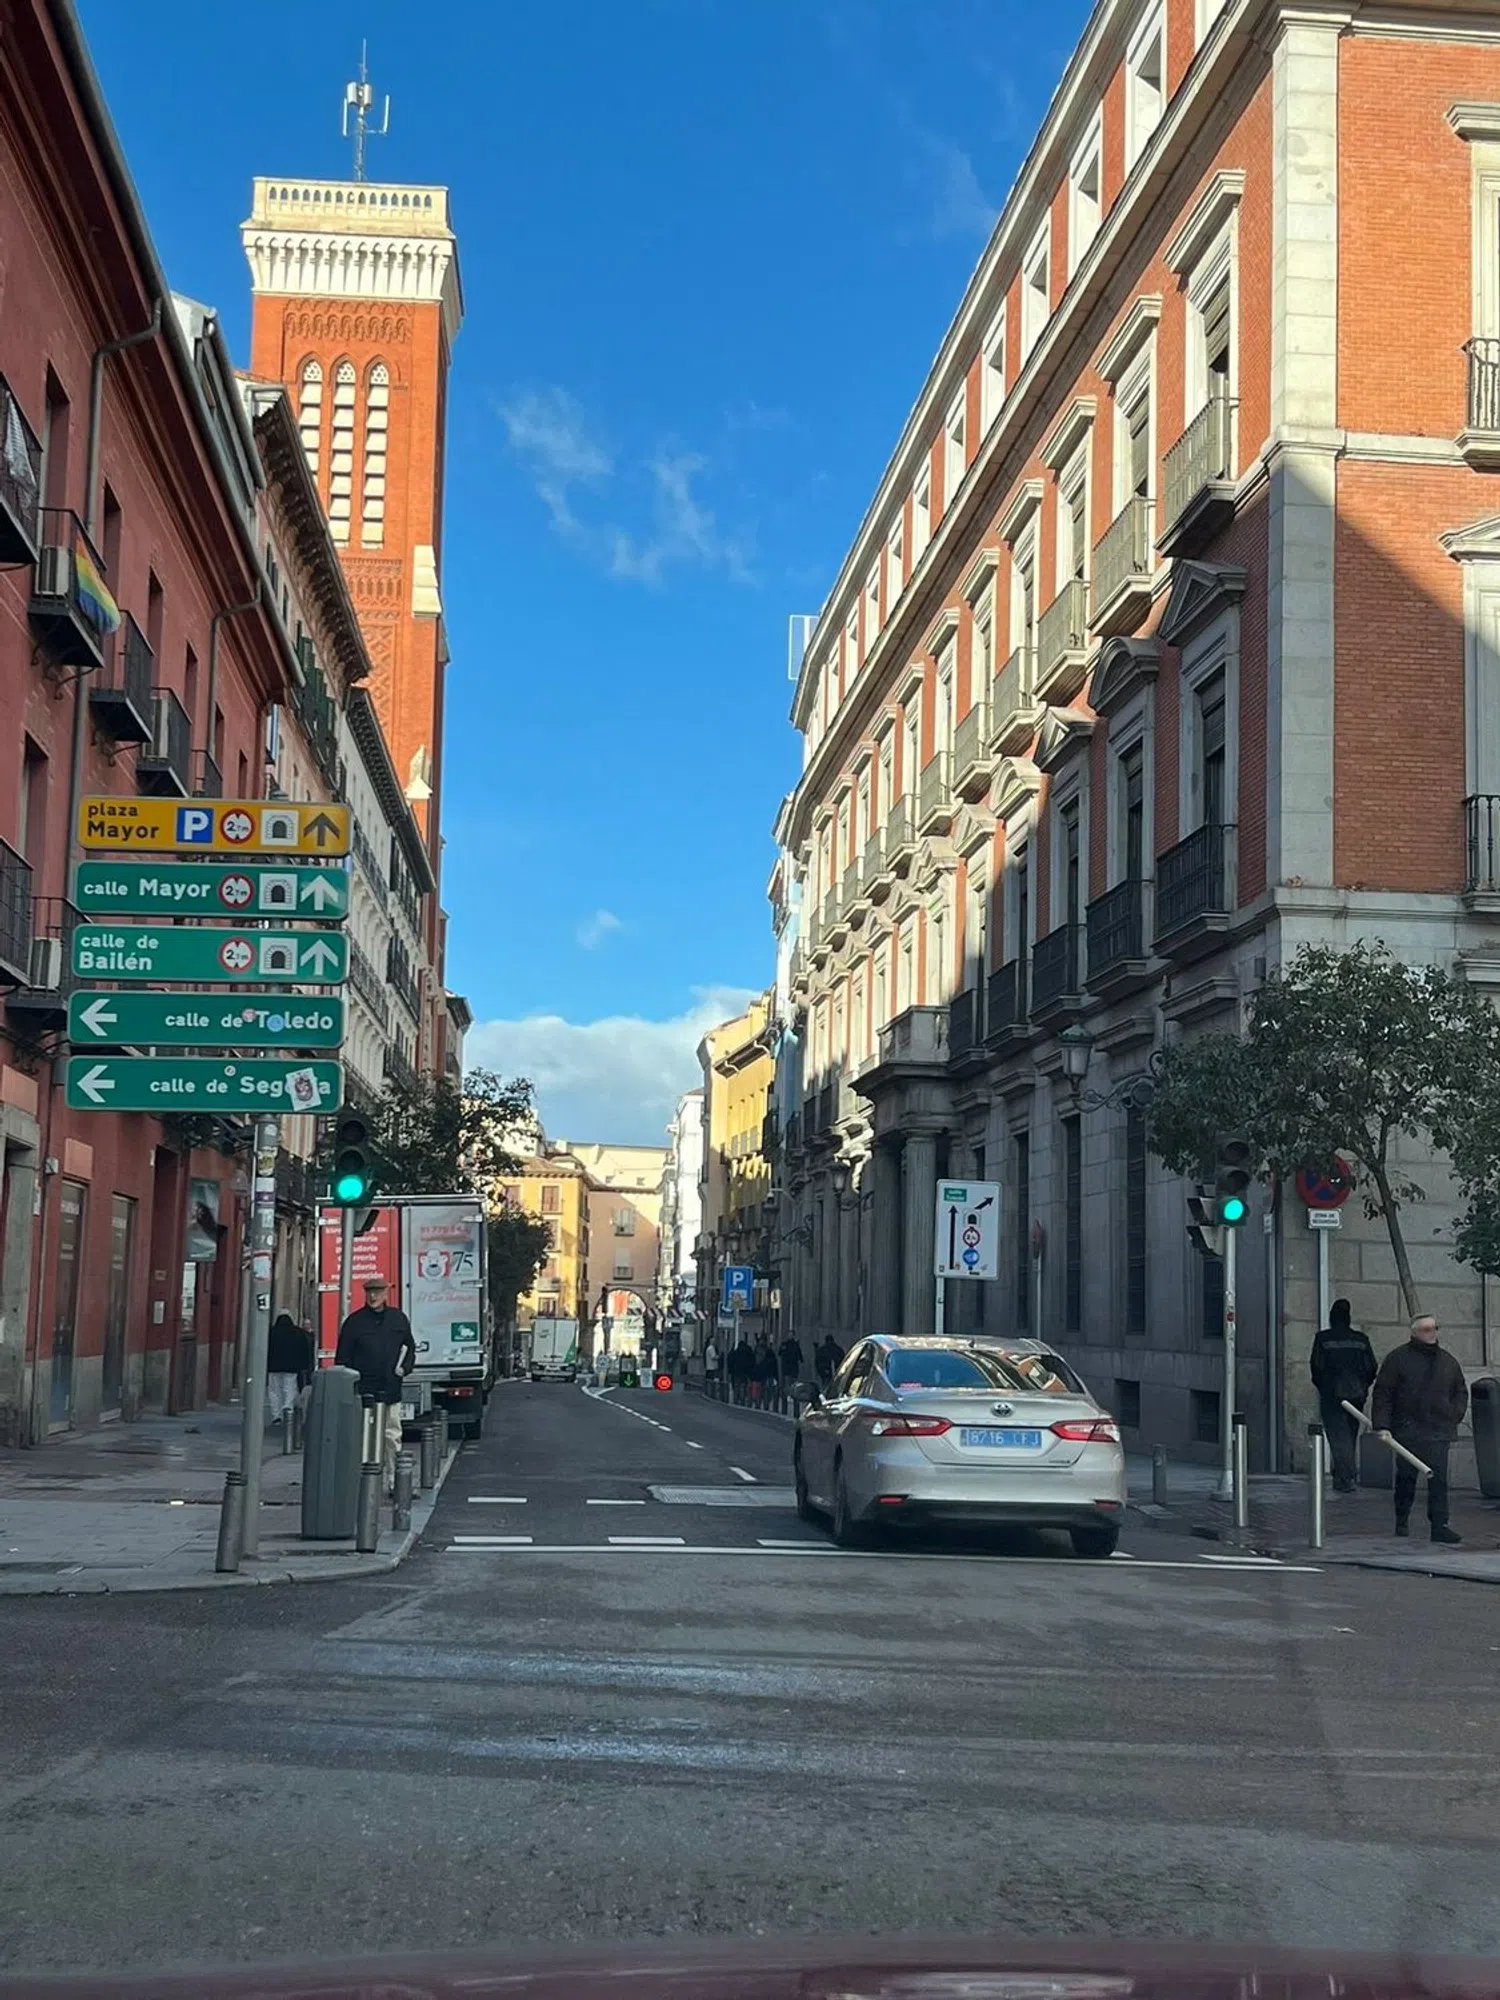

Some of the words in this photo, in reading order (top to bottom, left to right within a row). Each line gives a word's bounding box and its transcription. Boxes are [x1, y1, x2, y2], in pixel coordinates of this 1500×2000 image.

[87, 803, 138, 818] plaza
[87, 821, 160, 841] Mayor
[184, 810, 209, 840] P
[83, 881, 128, 895] calle
[139, 879, 210, 900] Mayor
[80, 934, 125, 948] calle
[136, 935, 159, 949] de
[79, 951, 152, 971] Bailén
[165, 1013, 210, 1027] calle
[221, 1014, 243, 1028] de
[256, 1011, 333, 1030] Tledo
[150, 1078, 195, 1093] calle
[206, 1079, 228, 1093] de
[240, 1076, 331, 1098] Sega
[453, 1251, 474, 1272] 75
[733, 1271, 744, 1286] P
